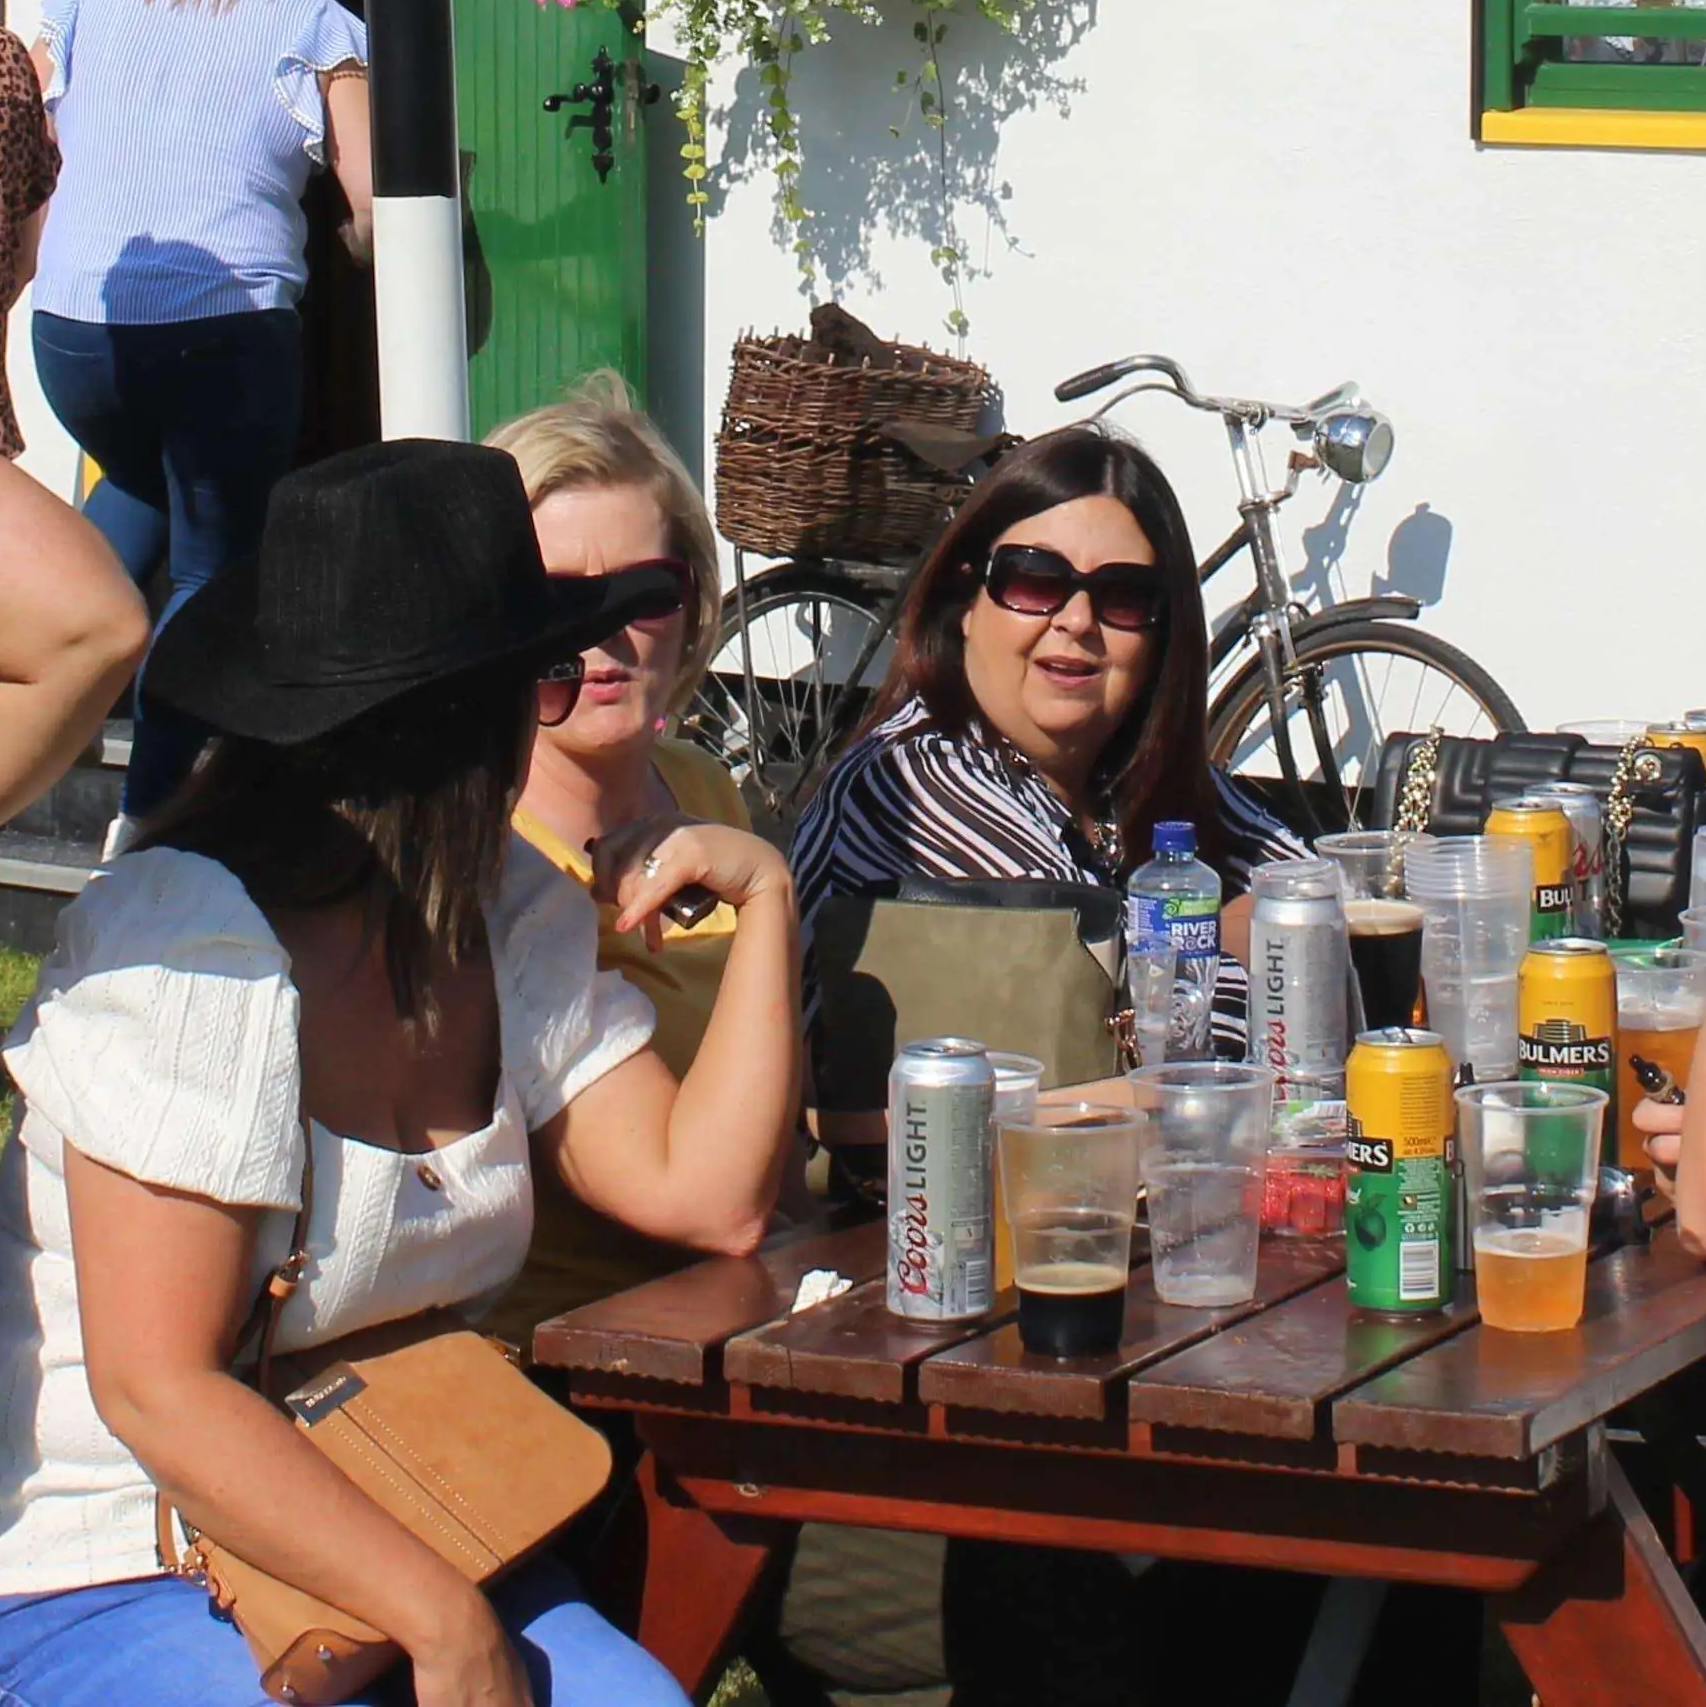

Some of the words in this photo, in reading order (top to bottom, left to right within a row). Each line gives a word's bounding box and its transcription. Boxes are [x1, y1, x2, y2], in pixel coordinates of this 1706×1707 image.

[1170, 920, 1217, 936] RIVER
[1265, 939, 1285, 1015] LIGHT
[1518, 1038, 1610, 1064] BULMERS
[905, 1101, 928, 1190] LIGHT
[897, 1193, 929, 1295] Coors
